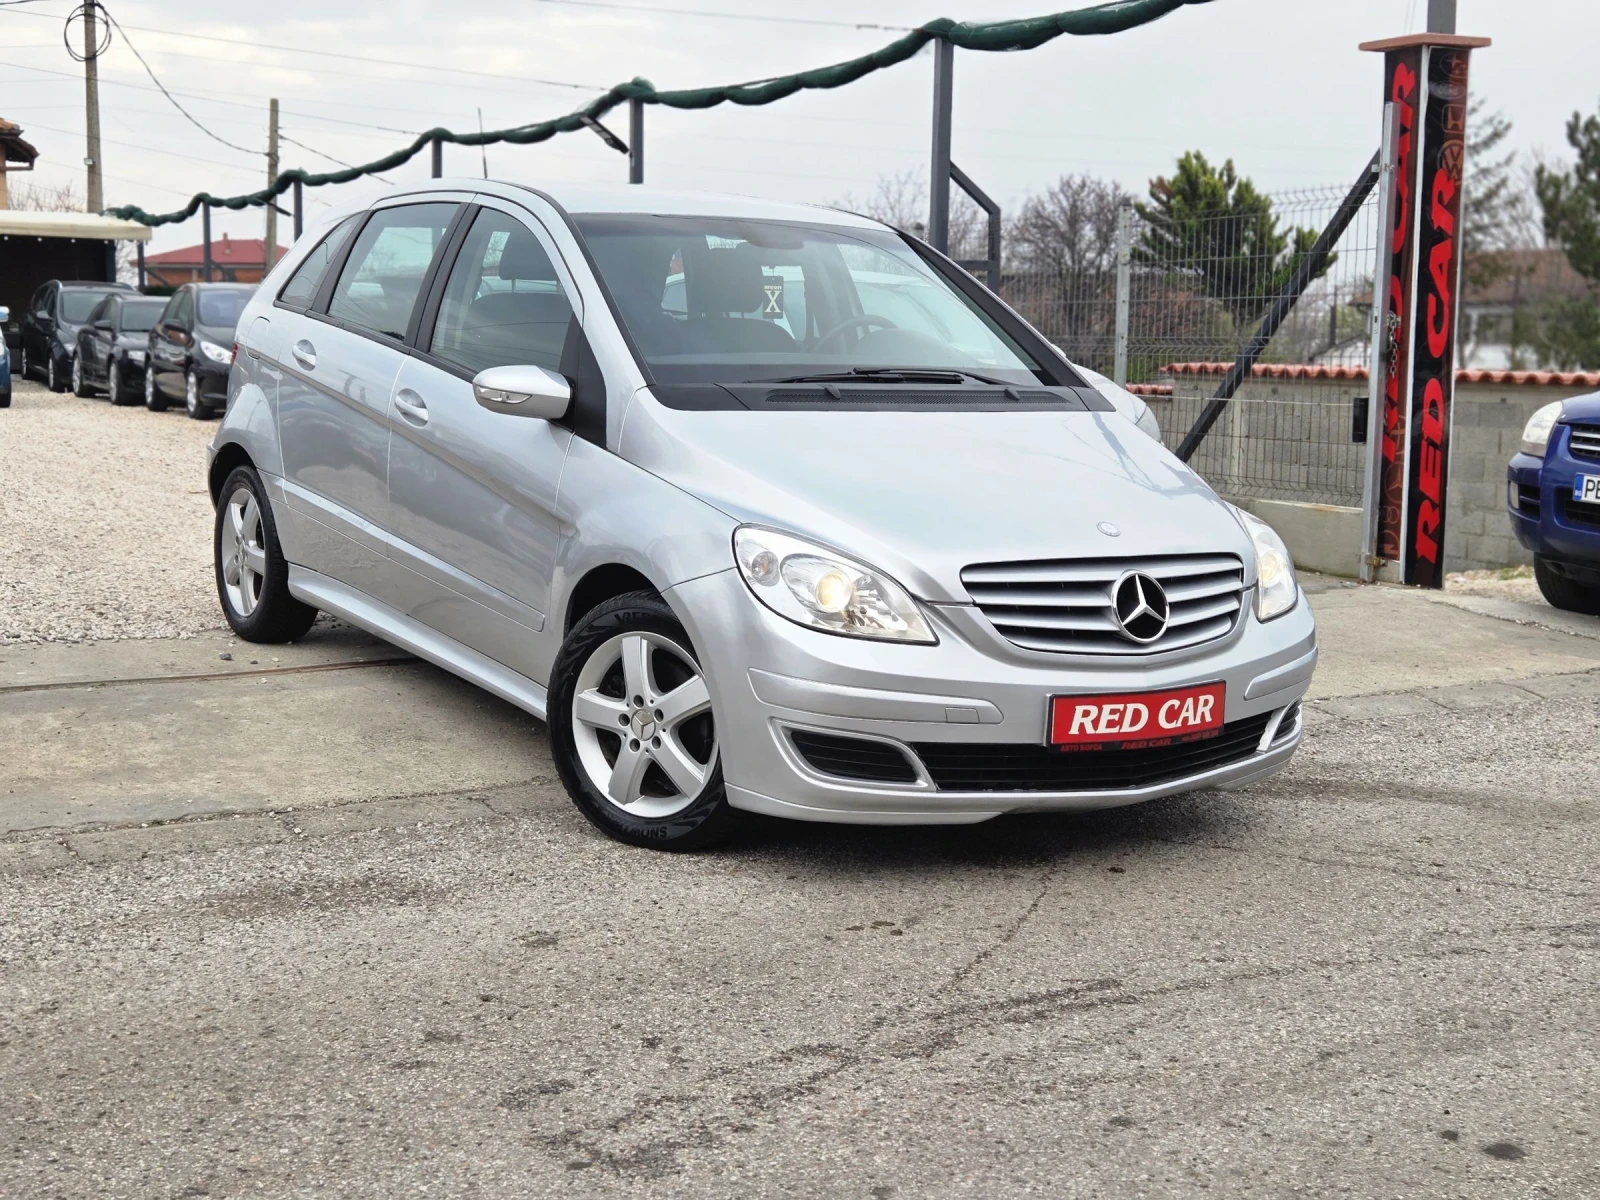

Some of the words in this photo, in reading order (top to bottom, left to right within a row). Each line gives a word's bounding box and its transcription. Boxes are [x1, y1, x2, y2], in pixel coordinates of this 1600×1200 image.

[1427, 168, 1455, 359] CAR
[764, 290, 782, 313] X
[1415, 377, 1445, 563] RED
[1068, 703, 1149, 735] RED
[1158, 694, 1215, 730] CAR
[1121, 742, 1147, 750] RED
[1149, 738, 1172, 747] CAR
